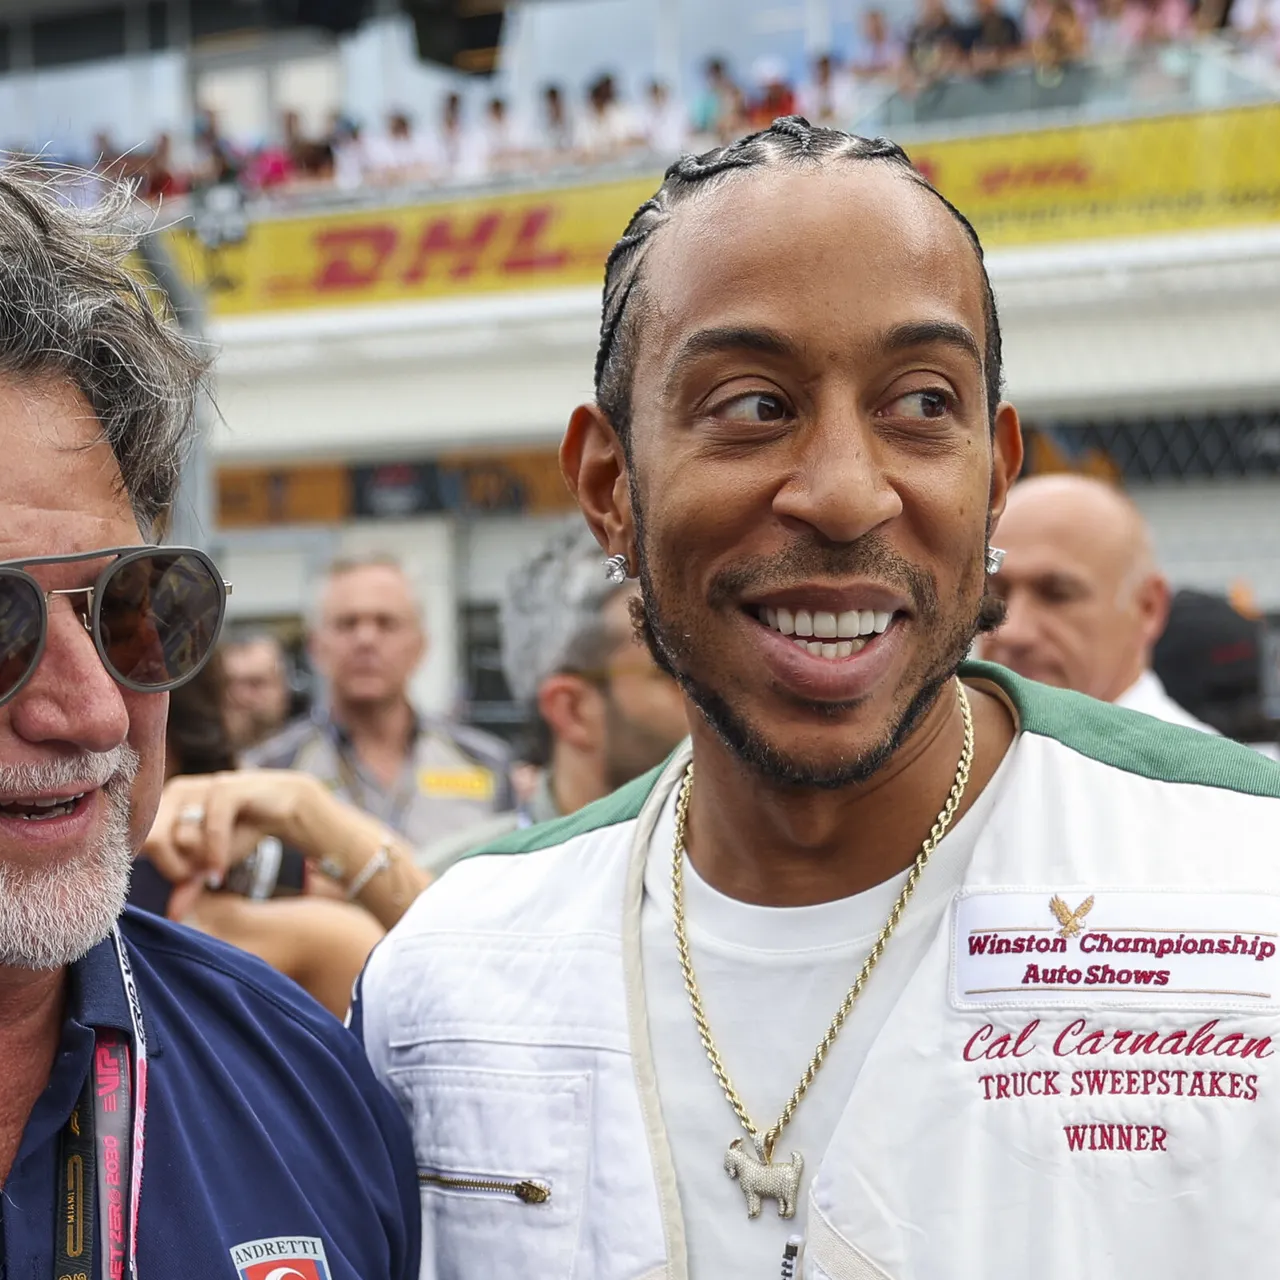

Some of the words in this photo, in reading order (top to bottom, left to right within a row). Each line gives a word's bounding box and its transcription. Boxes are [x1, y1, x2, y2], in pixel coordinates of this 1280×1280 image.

[312, 206, 572, 292] DHL
[968, 933, 1067, 956] Winston
[1079, 932, 1276, 961] Championship
[1021, 963, 1082, 985] Auto
[1083, 964, 1171, 986] Shows
[962, 1018, 1041, 1063] Cal
[1052, 1018, 1275, 1060] Carnahan
[978, 1070, 1061, 1100] TRUCK
[1069, 1068, 1259, 1102] SWEEPSTAKES
[1062, 1123, 1168, 1152] WINNER
[102, 1135, 121, 1186] 2030
[66, 1191, 76, 1224] MIAMI
[235, 1239, 320, 1265] ANDRETTI
